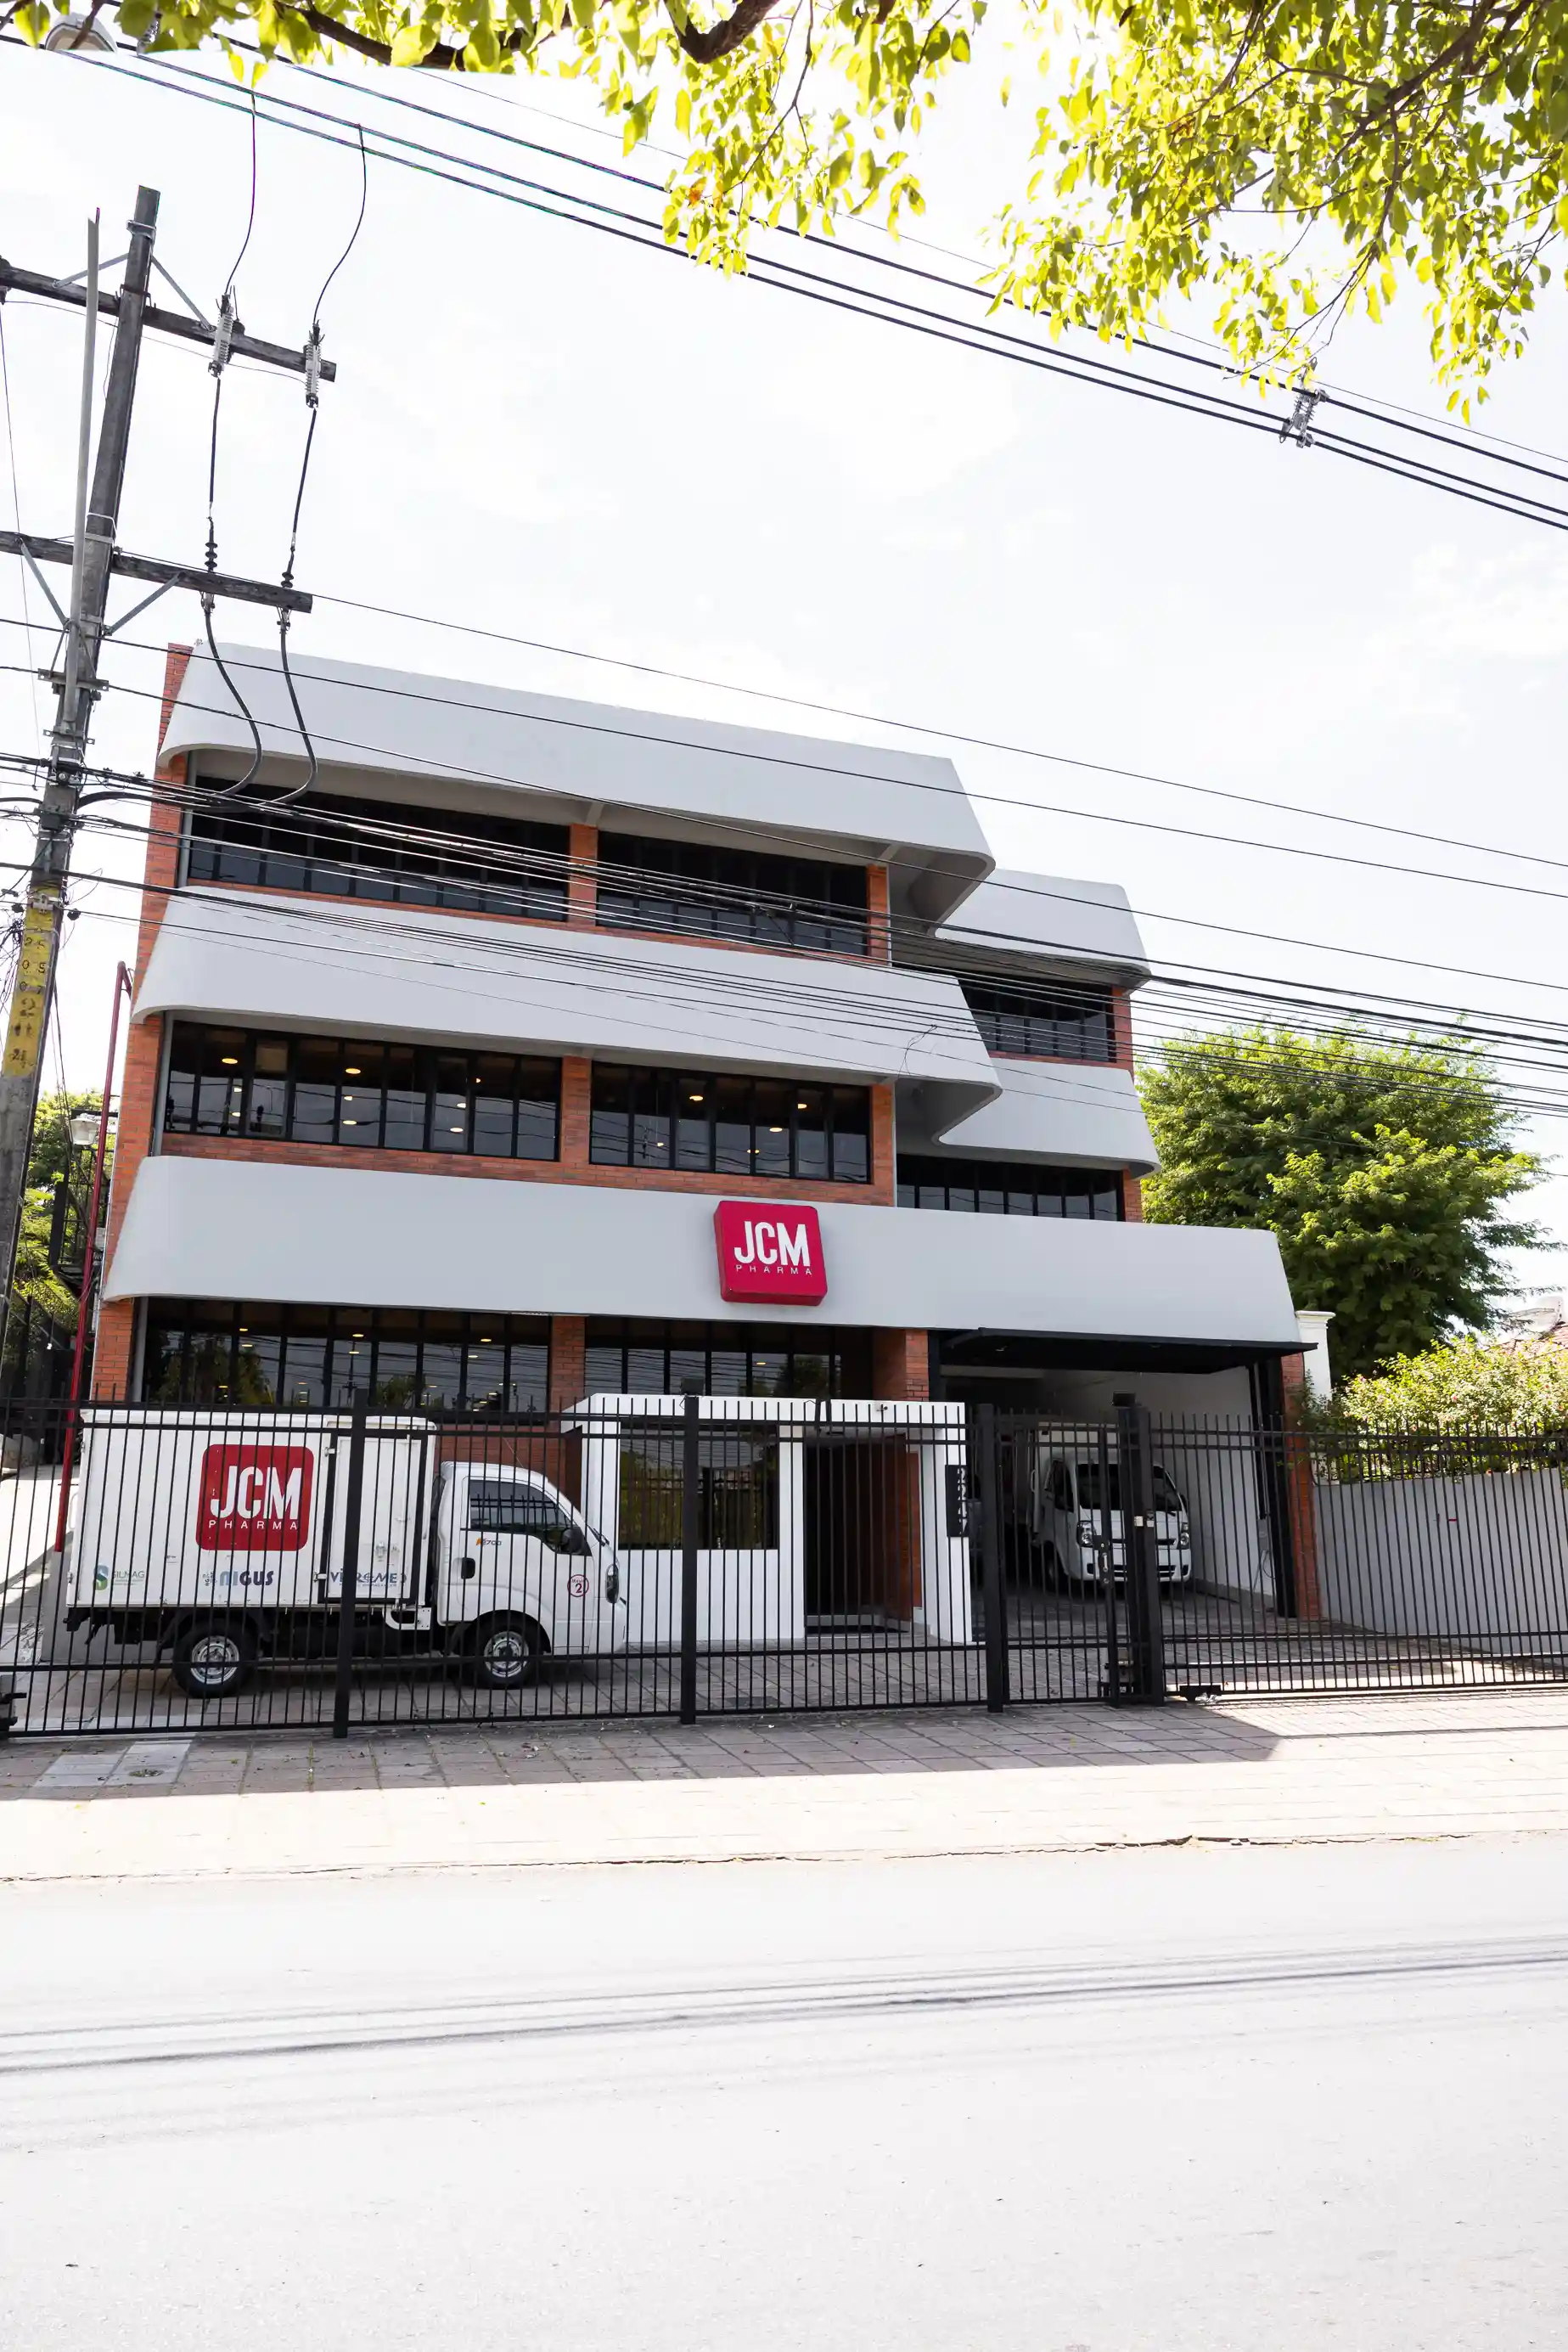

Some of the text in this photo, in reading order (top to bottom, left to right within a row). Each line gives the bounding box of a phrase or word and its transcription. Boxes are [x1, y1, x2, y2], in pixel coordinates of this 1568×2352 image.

[733, 1220, 811, 1267] JCM
[735, 1264, 812, 1275] PHARMA
[210, 1465, 302, 1520] JCM
[208, 1519, 298, 1530] PHARMA
[575, 1583, 582, 1594] 2
